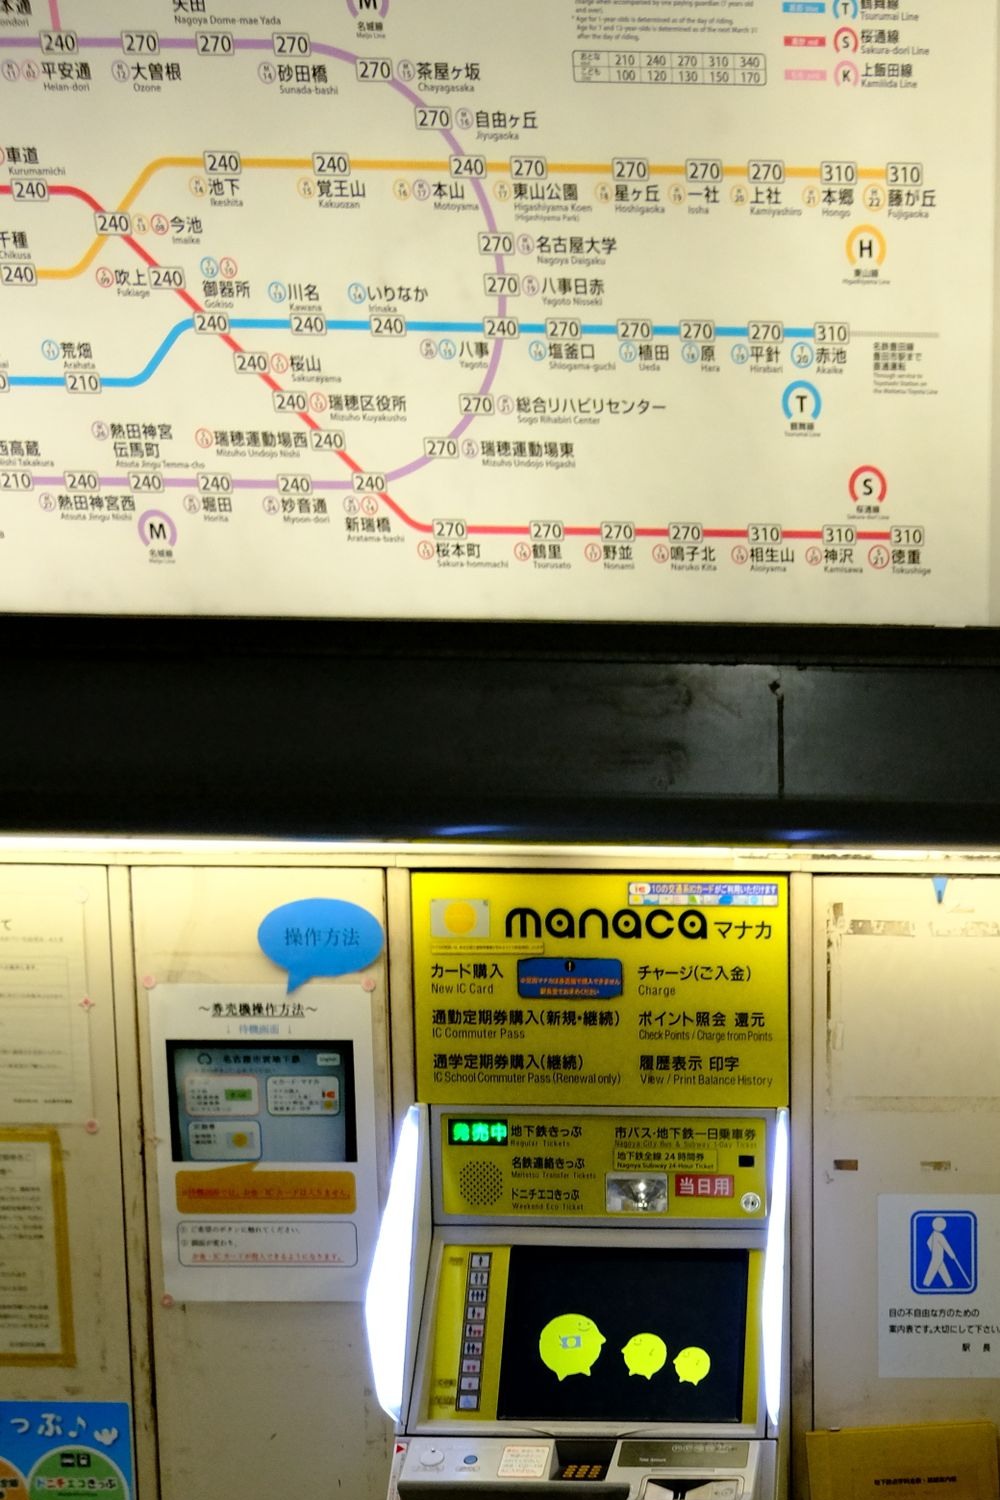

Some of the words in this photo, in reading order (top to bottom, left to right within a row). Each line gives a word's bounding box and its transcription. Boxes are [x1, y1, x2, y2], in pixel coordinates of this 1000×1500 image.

[44, 35, 75, 52] 240
[125, 36, 156, 52] 270
[200, 36, 231, 52] 270
[616, 55, 635, 65] 210
[646, 55, 666, 66] 240
[678, 56, 697, 67] 270
[710, 56, 728, 67] 310
[740, 57, 759, 68] 340
[41, 63, 91, 80] 平安通
[131, 64, 182, 81] 大曽根
[278, 65, 327, 83] 砂田橋
[417, 63, 480, 81] 茶屋ヶ坂
[862, 64, 912, 78] 上飯田線
[418, 84, 474, 93] Chayagasaka
[476, 112, 538, 129] 自由ヶ丘
[7, 148, 39, 164] 車道
[9, 167, 65, 175] Kurumamichi
[823, 166, 854, 182] 310
[889, 166, 920, 183] 310
[14, 183, 46, 198] 240
[208, 179, 239, 196] 池下
[317, 180, 366, 197] 覚王山
[433, 182, 464, 198] 本山
[513, 184, 577, 201] 東山公園
[615, 184, 660, 202] 星ヶ丘
[750, 188, 781, 205] 上社
[822, 189, 854, 206] 本郷
[888, 190, 936, 207] 藤が丘
[170, 217, 202, 234] 今池
[537, 237, 616, 254] 名古屋大学
[860, 240, 872, 258] H
[537, 255, 568, 266] Nagoya
[570, 256, 605, 266] Daigaku
[288, 284, 319, 300] 川名
[368, 287, 428, 302] いりなか
[542, 278, 604, 296] 八事日赤
[750, 346, 780, 363] 平針
[816, 347, 847, 364] 赤池
[290, 355, 321, 372] 桜山
[70, 376, 98, 391] 210
[329, 394, 407, 412] 瑞穂区役所
[516, 398, 666, 415] 総合リハビリセンター
[796, 396, 807, 413] T
[215, 431, 308, 448] 瑞穂運動場西
[481, 441, 574, 458] 瑞穂運動場東
[863, 479, 873, 496] S
[58, 494, 135, 512] 熱田神宮西
[150, 523, 166, 539] M
[346, 517, 391, 534] 新瑞橋
[603, 544, 633, 561] 野並
[750, 548, 794, 564] 相生山
[892, 549, 921, 566] 徳重
[505, 907, 708, 939] manaca
[714, 921, 772, 939] マナカ
[284, 928, 360, 946] 操作方法
[431, 963, 503, 978] カード購入
[638, 965, 752, 982] チャージ(ご入金)
[432, 984, 452, 995] New
[456, 984, 465, 994] IC
[468, 984, 494, 995] Card
[638, 985, 676, 997] Charge
[432, 1010, 620, 1027] 通勤定期券購入(新規・継続)
[639, 1011, 726, 1028] ポイント照会
[735, 1012, 765, 1028] 還元
[432, 1028, 442, 1039] IC
[444, 1028, 497, 1039] Commuter
[501, 1029, 525, 1039] Pass
[638, 1029, 663, 1041] Check
[665, 1030, 689, 1041] Points
[699, 1030, 726, 1042] Charge
[728, 1030, 746, 1041] from
[748, 1030, 773, 1041] Points
[433, 1054, 583, 1071] 通学定期券購入(継続)
[639, 1056, 702, 1071] 履歴表示
[709, 1057, 739, 1071] 印字
[434, 1072, 442, 1083] IC
[445, 1072, 476, 1083] School
[477, 1072, 525, 1083] Commuter
[528, 1073, 551, 1083] Pass
[553, 1073, 596, 1085] (Renewal
[598, 1074, 620, 1085] only)
[640, 1073, 664, 1085] View
[674, 1073, 696, 1085] Print
[698, 1074, 735, 1085] Balance
[738, 1074, 772, 1088] History
[453, 1123, 508, 1142] 発売中
[511, 1126, 582, 1137] 地下鉄きっぷ
[615, 1127, 756, 1140] 市バス・地下鉄一日乗車券
[512, 1157, 585, 1169] 名鉄連絡きっぷ
[617, 1151, 662, 1160] 地下鉄全線
[665, 1152, 675, 1160] 24
[678, 1153, 704, 1161] 時間券
[511, 1188, 579, 1200] ドニチエコきっぷ
[679, 1177, 729, 1194] 当日用
[889, 1308, 980, 1318] 目の不自由な方のための
